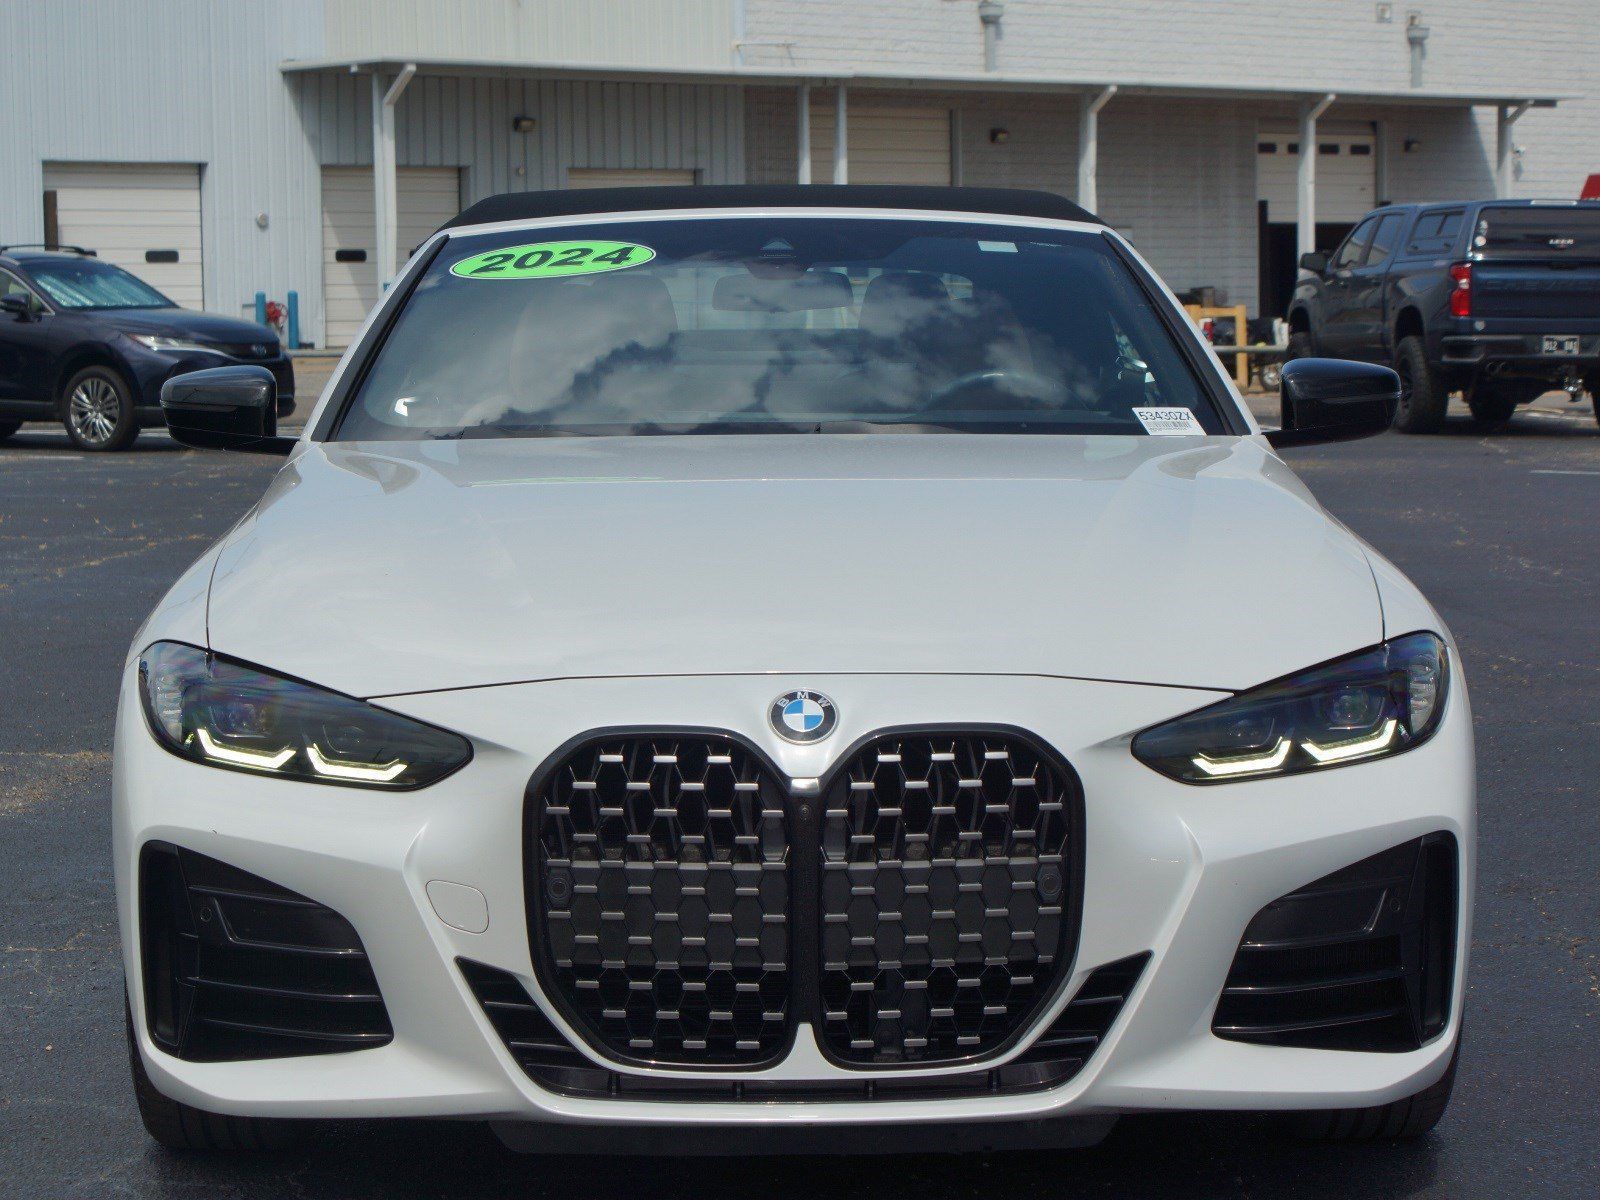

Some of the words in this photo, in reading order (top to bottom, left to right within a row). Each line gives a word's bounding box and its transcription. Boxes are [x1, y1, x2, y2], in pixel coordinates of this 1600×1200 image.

[469, 246, 638, 274] 2024
[1138, 411, 1193, 420] 53430ZX
[777, 691, 830, 707] BMW
